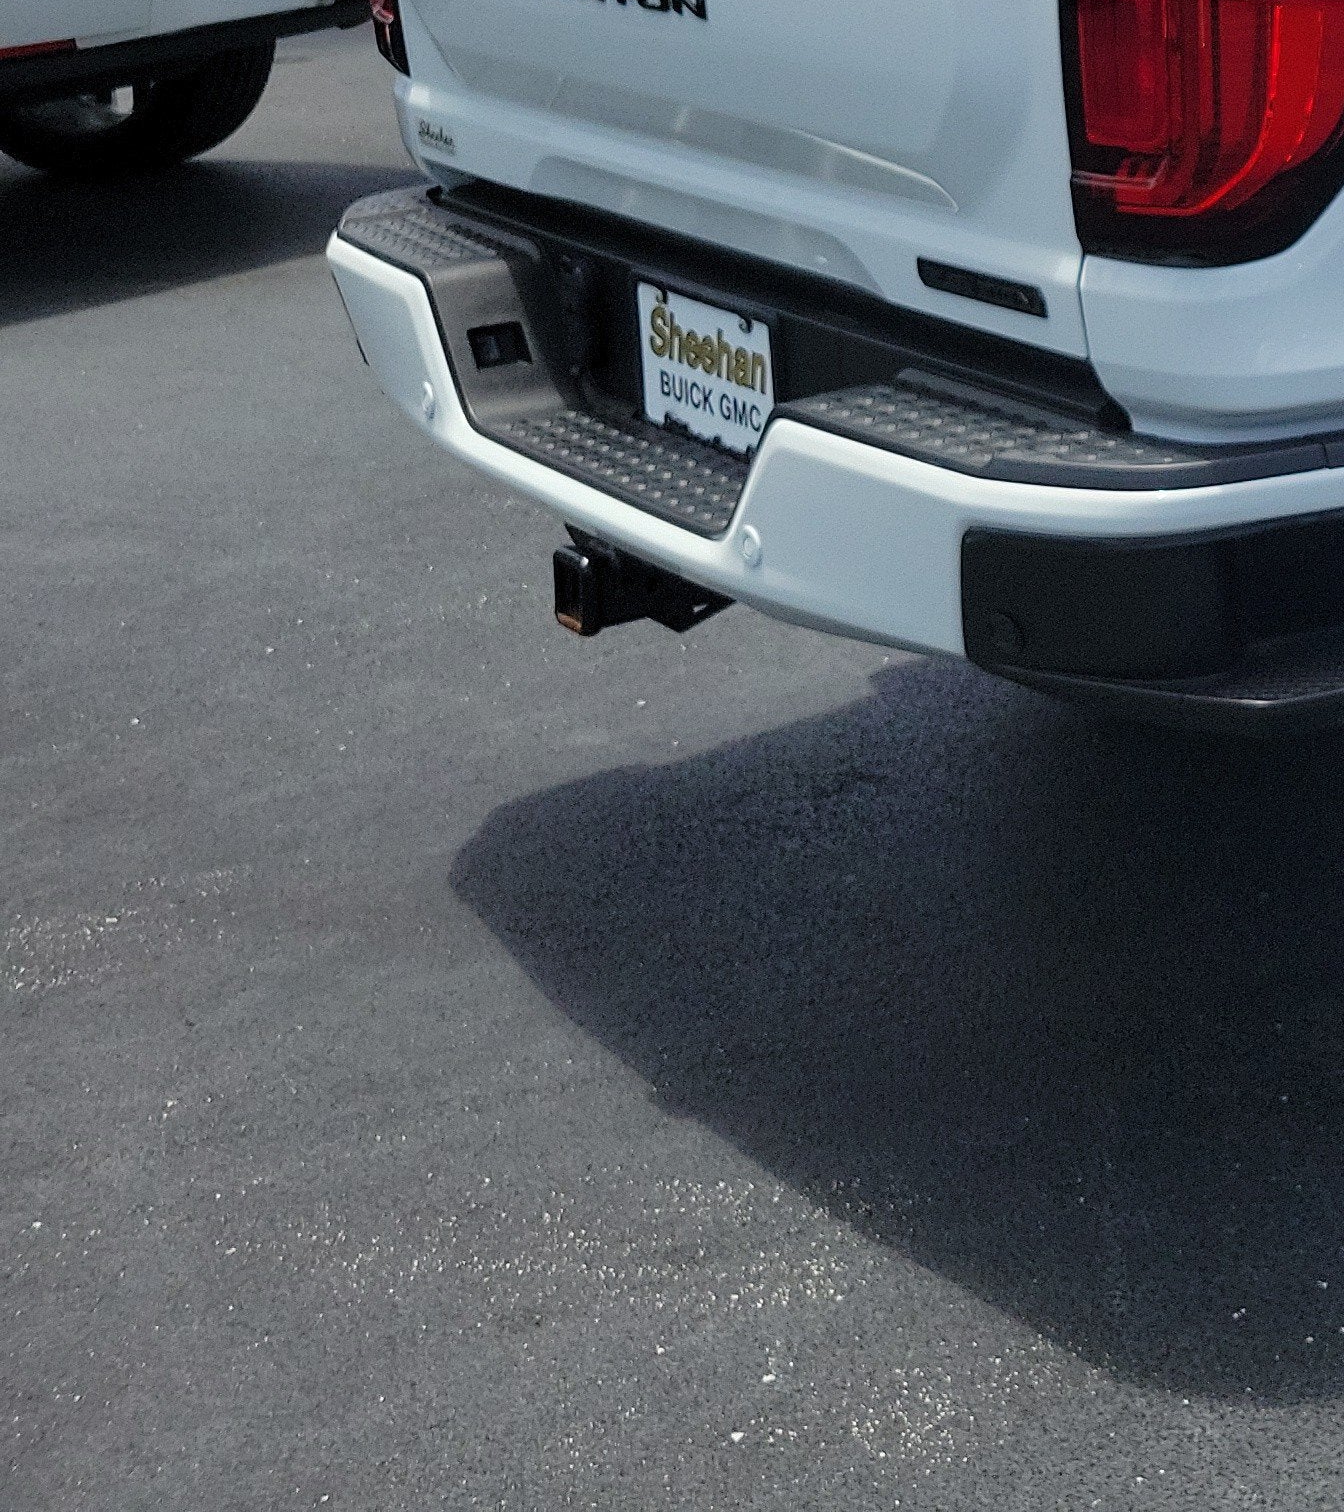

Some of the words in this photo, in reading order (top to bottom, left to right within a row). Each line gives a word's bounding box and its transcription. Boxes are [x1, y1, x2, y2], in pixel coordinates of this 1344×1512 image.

[650, 305, 768, 395] Sheehan
[660, 369, 715, 417] BUICK
[719, 392, 763, 432] GMC
